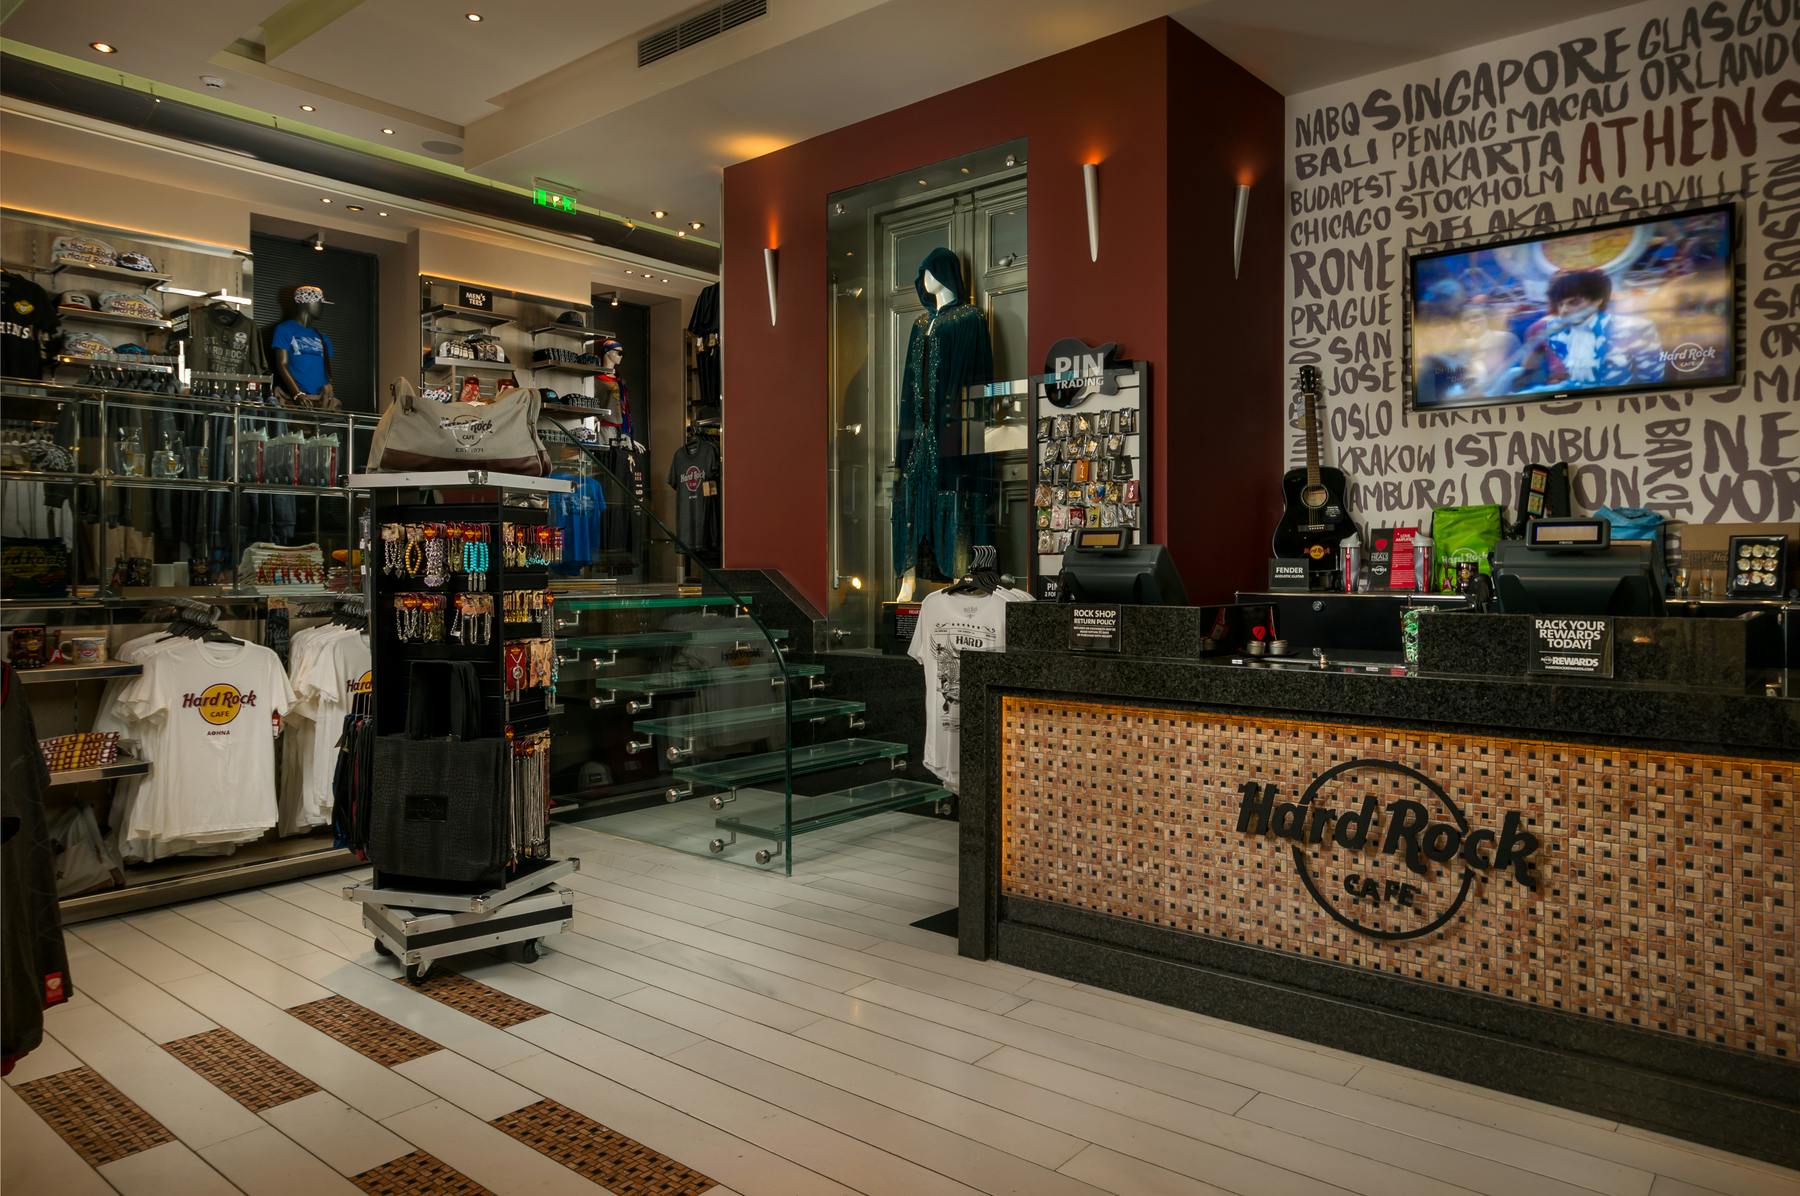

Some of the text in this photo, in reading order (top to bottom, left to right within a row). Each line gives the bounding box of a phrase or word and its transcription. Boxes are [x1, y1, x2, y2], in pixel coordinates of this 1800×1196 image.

[1638, 0, 1800, 61] GLASGO
[1362, 27, 1631, 131] SINGAPORE
[1295, 102, 1360, 148] NABQ
[1507, 81, 1629, 133] MACAU
[1392, 111, 1497, 160] PENANG
[1578, 79, 1800, 185] ATHENS
[1295, 138, 1378, 180] BALI
[1400, 131, 1565, 193] JAKARTA
[1291, 170, 1397, 216] BUDAPEST
[1395, 166, 1563, 219] STOCKHOLM
[1291, 206, 1391, 247] CHICAGO
[1289, 237, 1396, 299] ROME
[1291, 293, 1393, 336] PRAGUE
[1055, 353, 1104, 380] PIN
[1328, 329, 1392, 364] SAN
[1659, 346, 1716, 362] Hard Rock
[1056, 377, 1104, 390] TRADING
[1327, 361, 1397, 396] JOSE
[1331, 400, 1393, 442] OSLO
[1337, 443, 1436, 477] KRAKOW
[1444, 424, 1639, 469] ISTANBUL
[1643, 418, 1694, 524] BARCE
[1345, 477, 1456, 514] AMBURG
[1073, 609, 1117, 618] ROCK SHOP
[1535, 619, 1605, 631] RACK YOUR
[955, 635, 984, 649] HARD
[1539, 629, 1601, 640] REWARDS
[1547, 639, 1592, 650] TODAY!
[1552, 656, 1599, 667] REWARDS
[182, 690, 257, 708] Hard Rock
[1236, 781, 1539, 893] Hard Rock
[1343, 874, 1421, 907] CAFE
